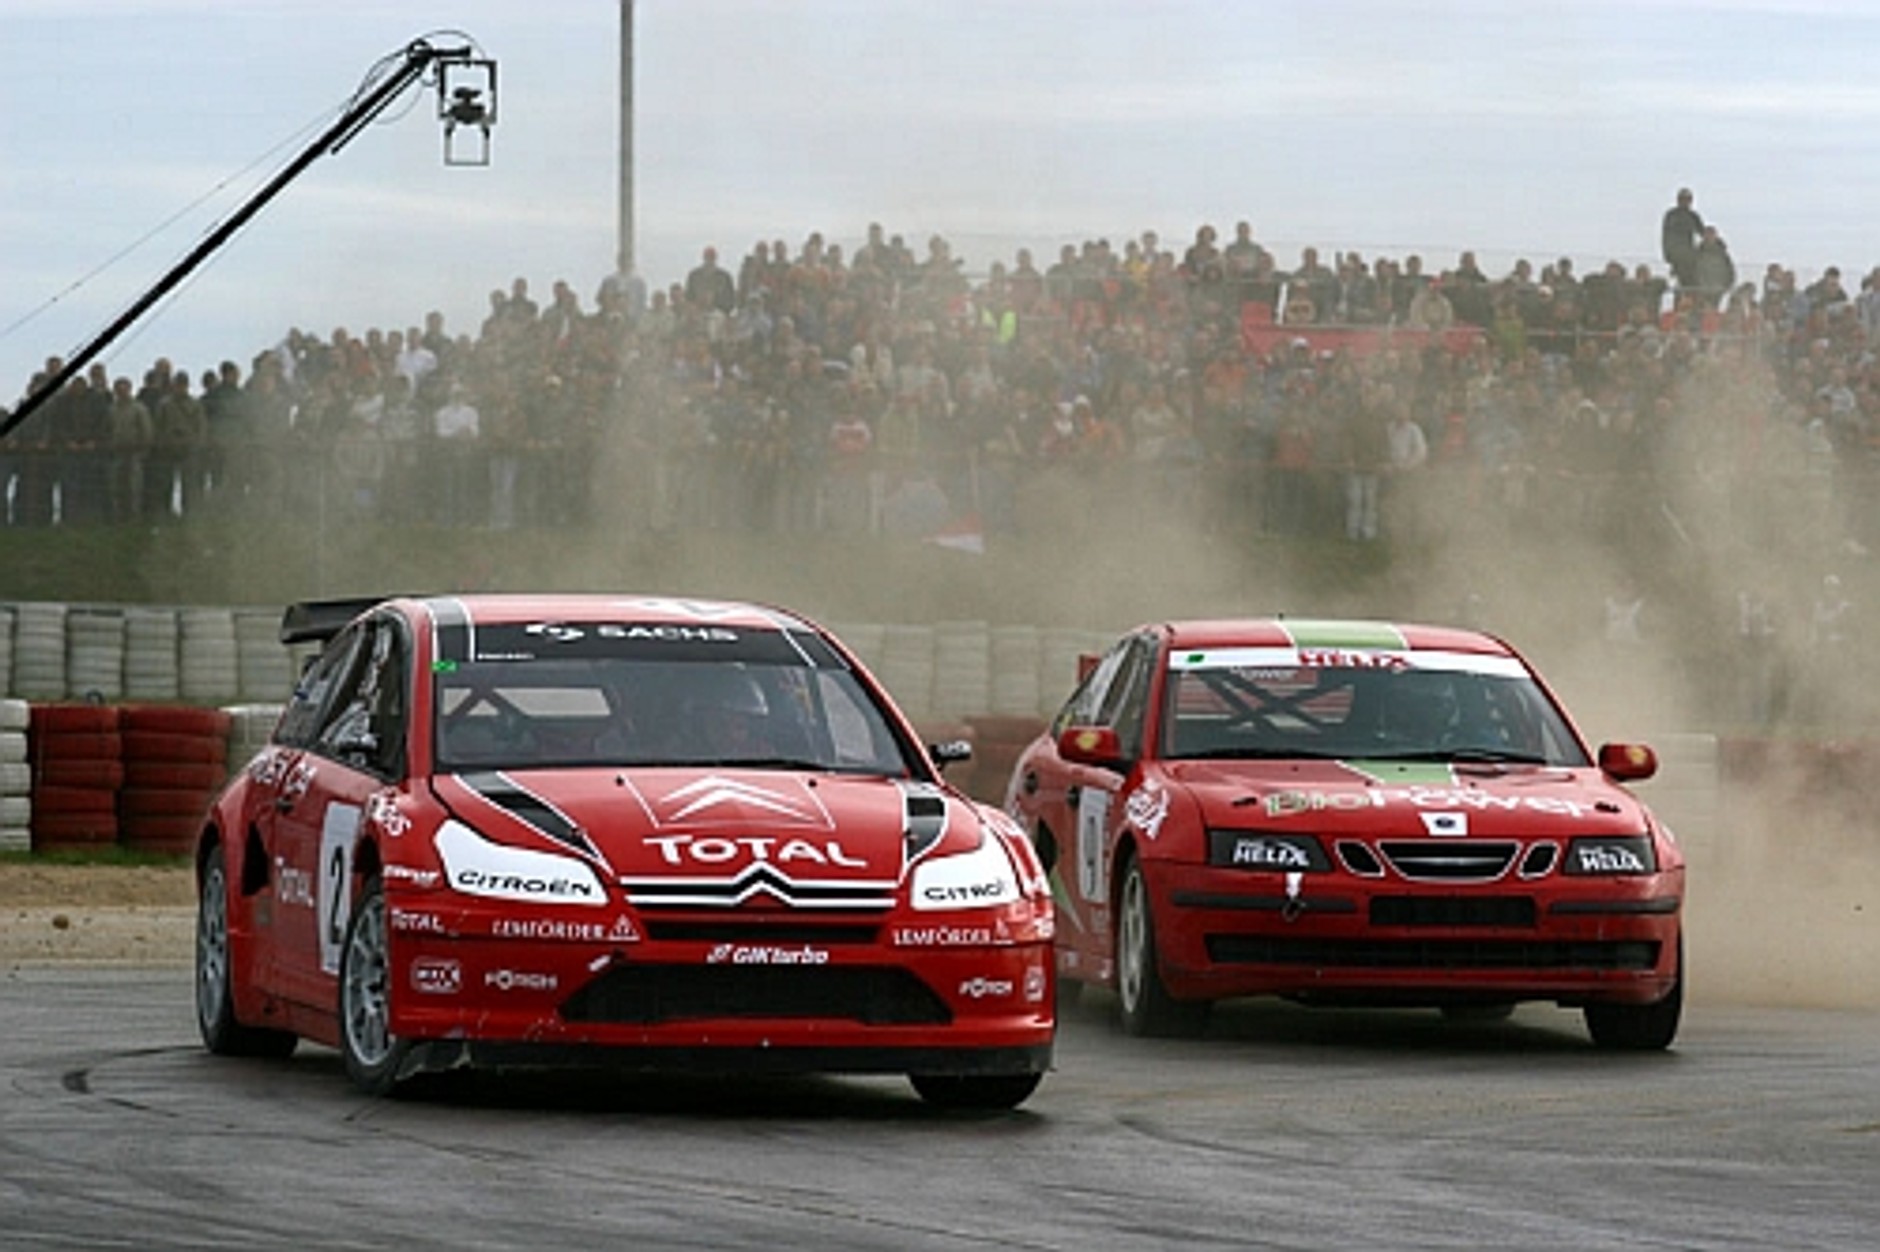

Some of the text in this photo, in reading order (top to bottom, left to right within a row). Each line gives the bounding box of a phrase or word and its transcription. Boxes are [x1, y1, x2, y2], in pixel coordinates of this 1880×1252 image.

[598, 624, 739, 642] SACHS
[642, 835, 868, 867] TOTAL
[330, 846, 344, 945] 2
[457, 871, 592, 897] CITROËN
[391, 909, 448, 933] TOTAL
